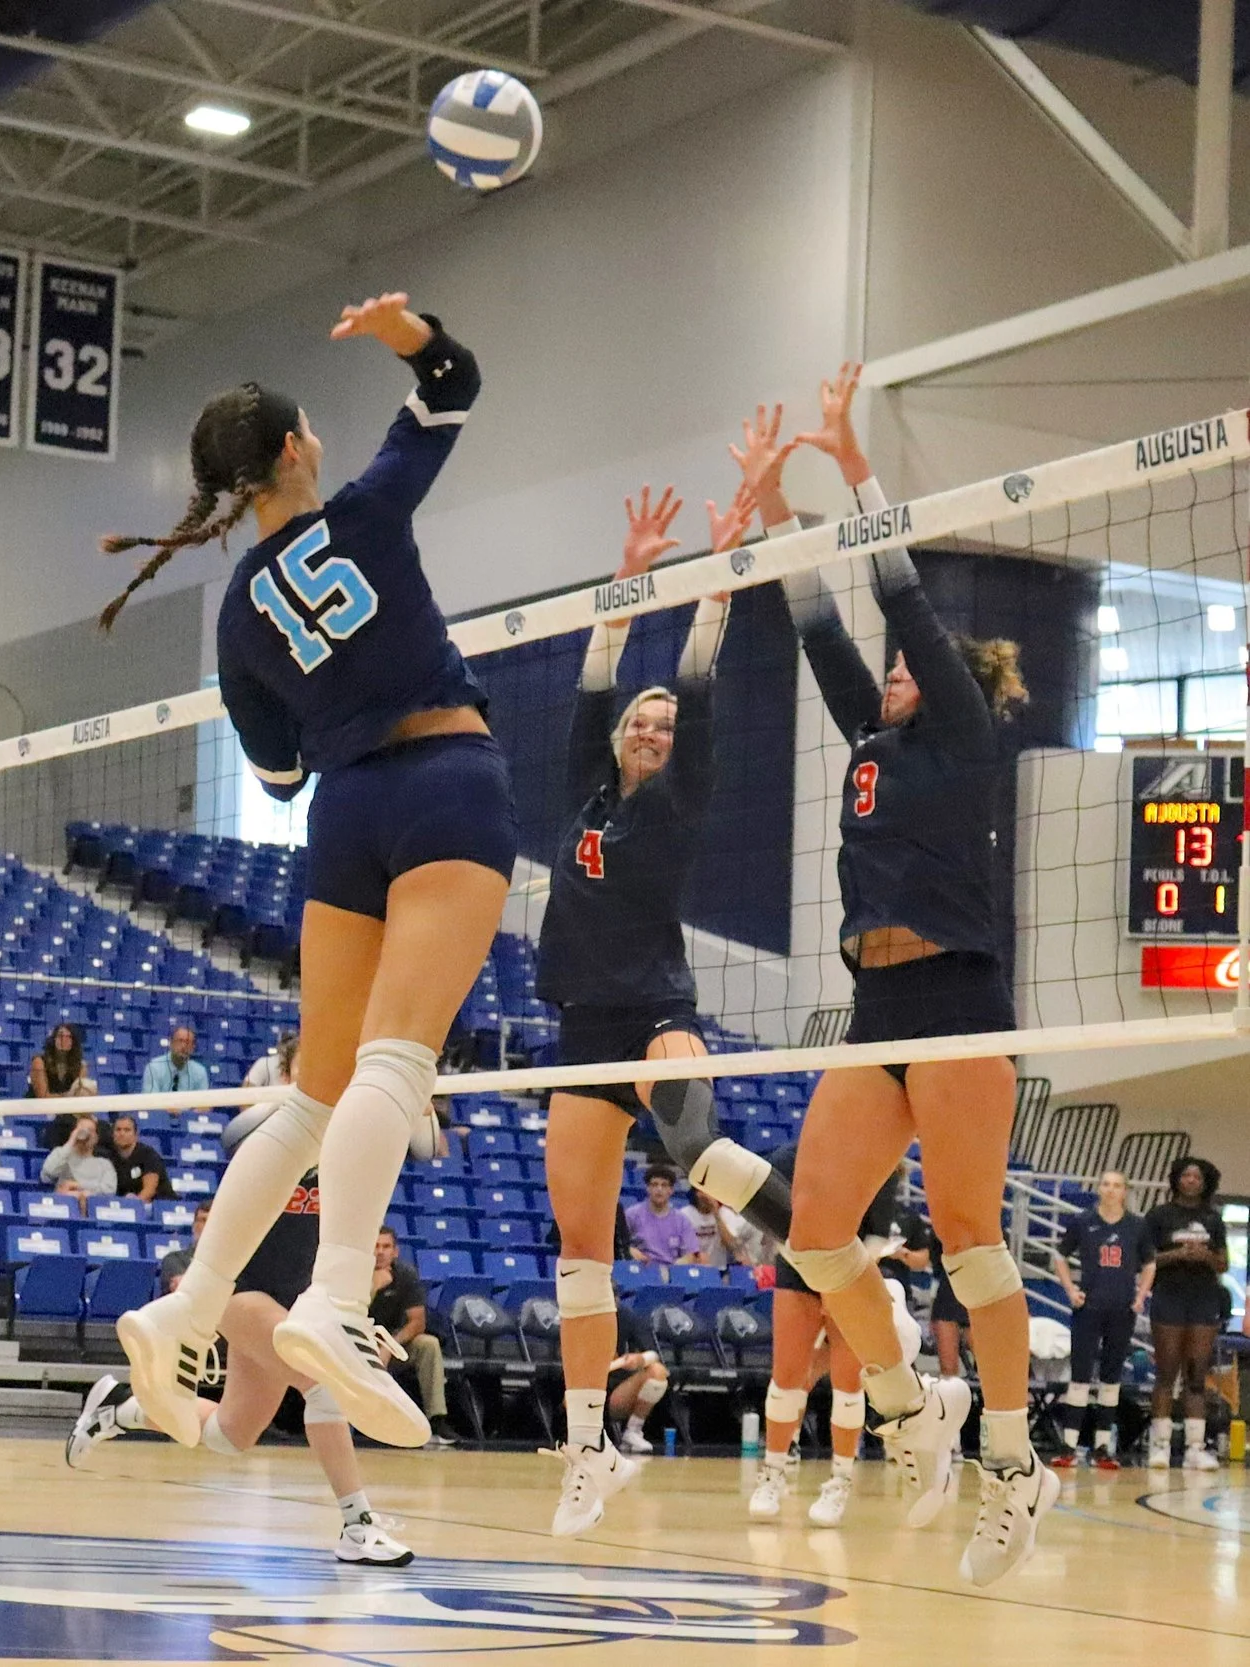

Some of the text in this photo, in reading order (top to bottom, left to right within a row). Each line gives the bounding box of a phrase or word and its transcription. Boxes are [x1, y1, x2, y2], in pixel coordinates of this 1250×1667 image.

[43, 338, 109, 396] 32
[1135, 418, 1230, 471] AUGUSTA
[836, 505, 913, 551] AUGUSTA
[250, 518, 378, 675] 15
[594, 574, 657, 613] AUGUSTA
[72, 717, 111, 746] AUGUSTA
[853, 761, 879, 817] 9
[1144, 802, 1221, 824] AUGUSTA
[576, 829, 604, 879] 4
[1176, 826, 1214, 867] 13
[1156, 882, 1226, 915] 0 1
